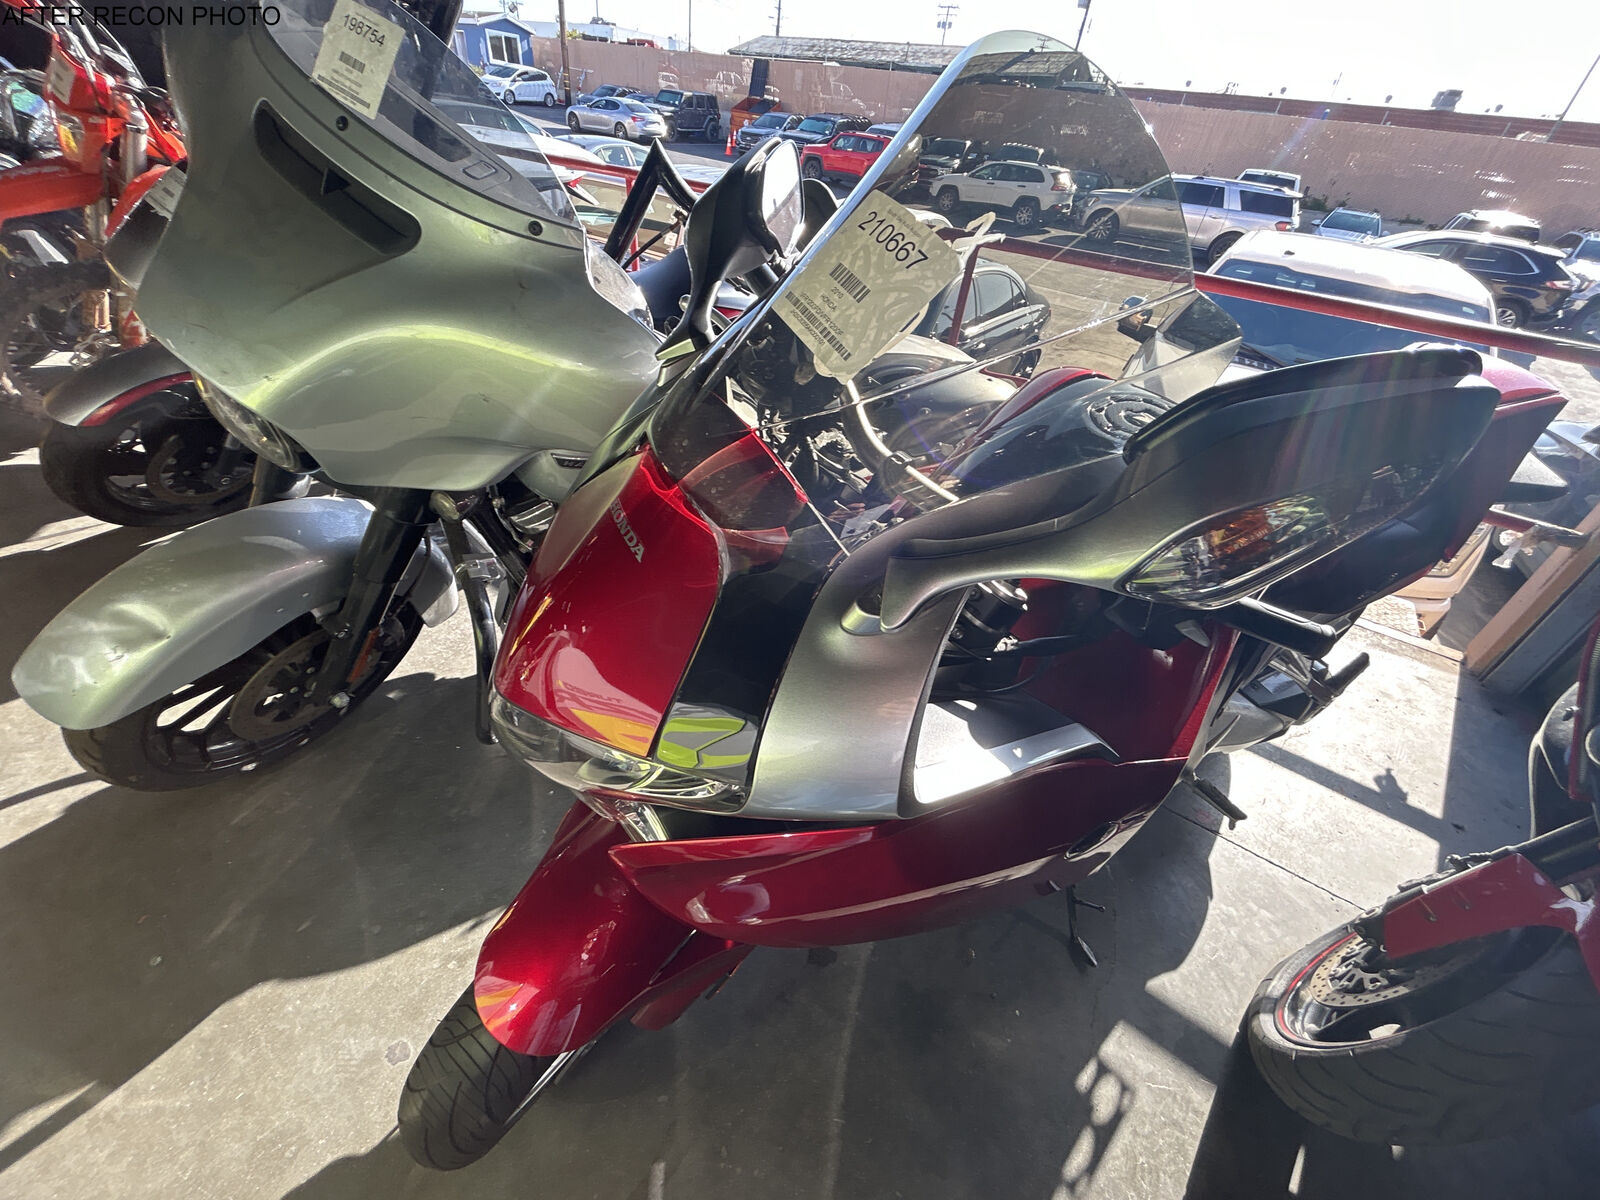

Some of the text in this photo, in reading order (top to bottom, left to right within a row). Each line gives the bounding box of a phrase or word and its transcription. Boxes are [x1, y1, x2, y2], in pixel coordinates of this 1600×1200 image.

[343, 14, 386, 47] 198754
[857, 210, 929, 270] 210667
[820, 293, 838, 312] HONDA
[610, 497, 645, 564] HONDA
